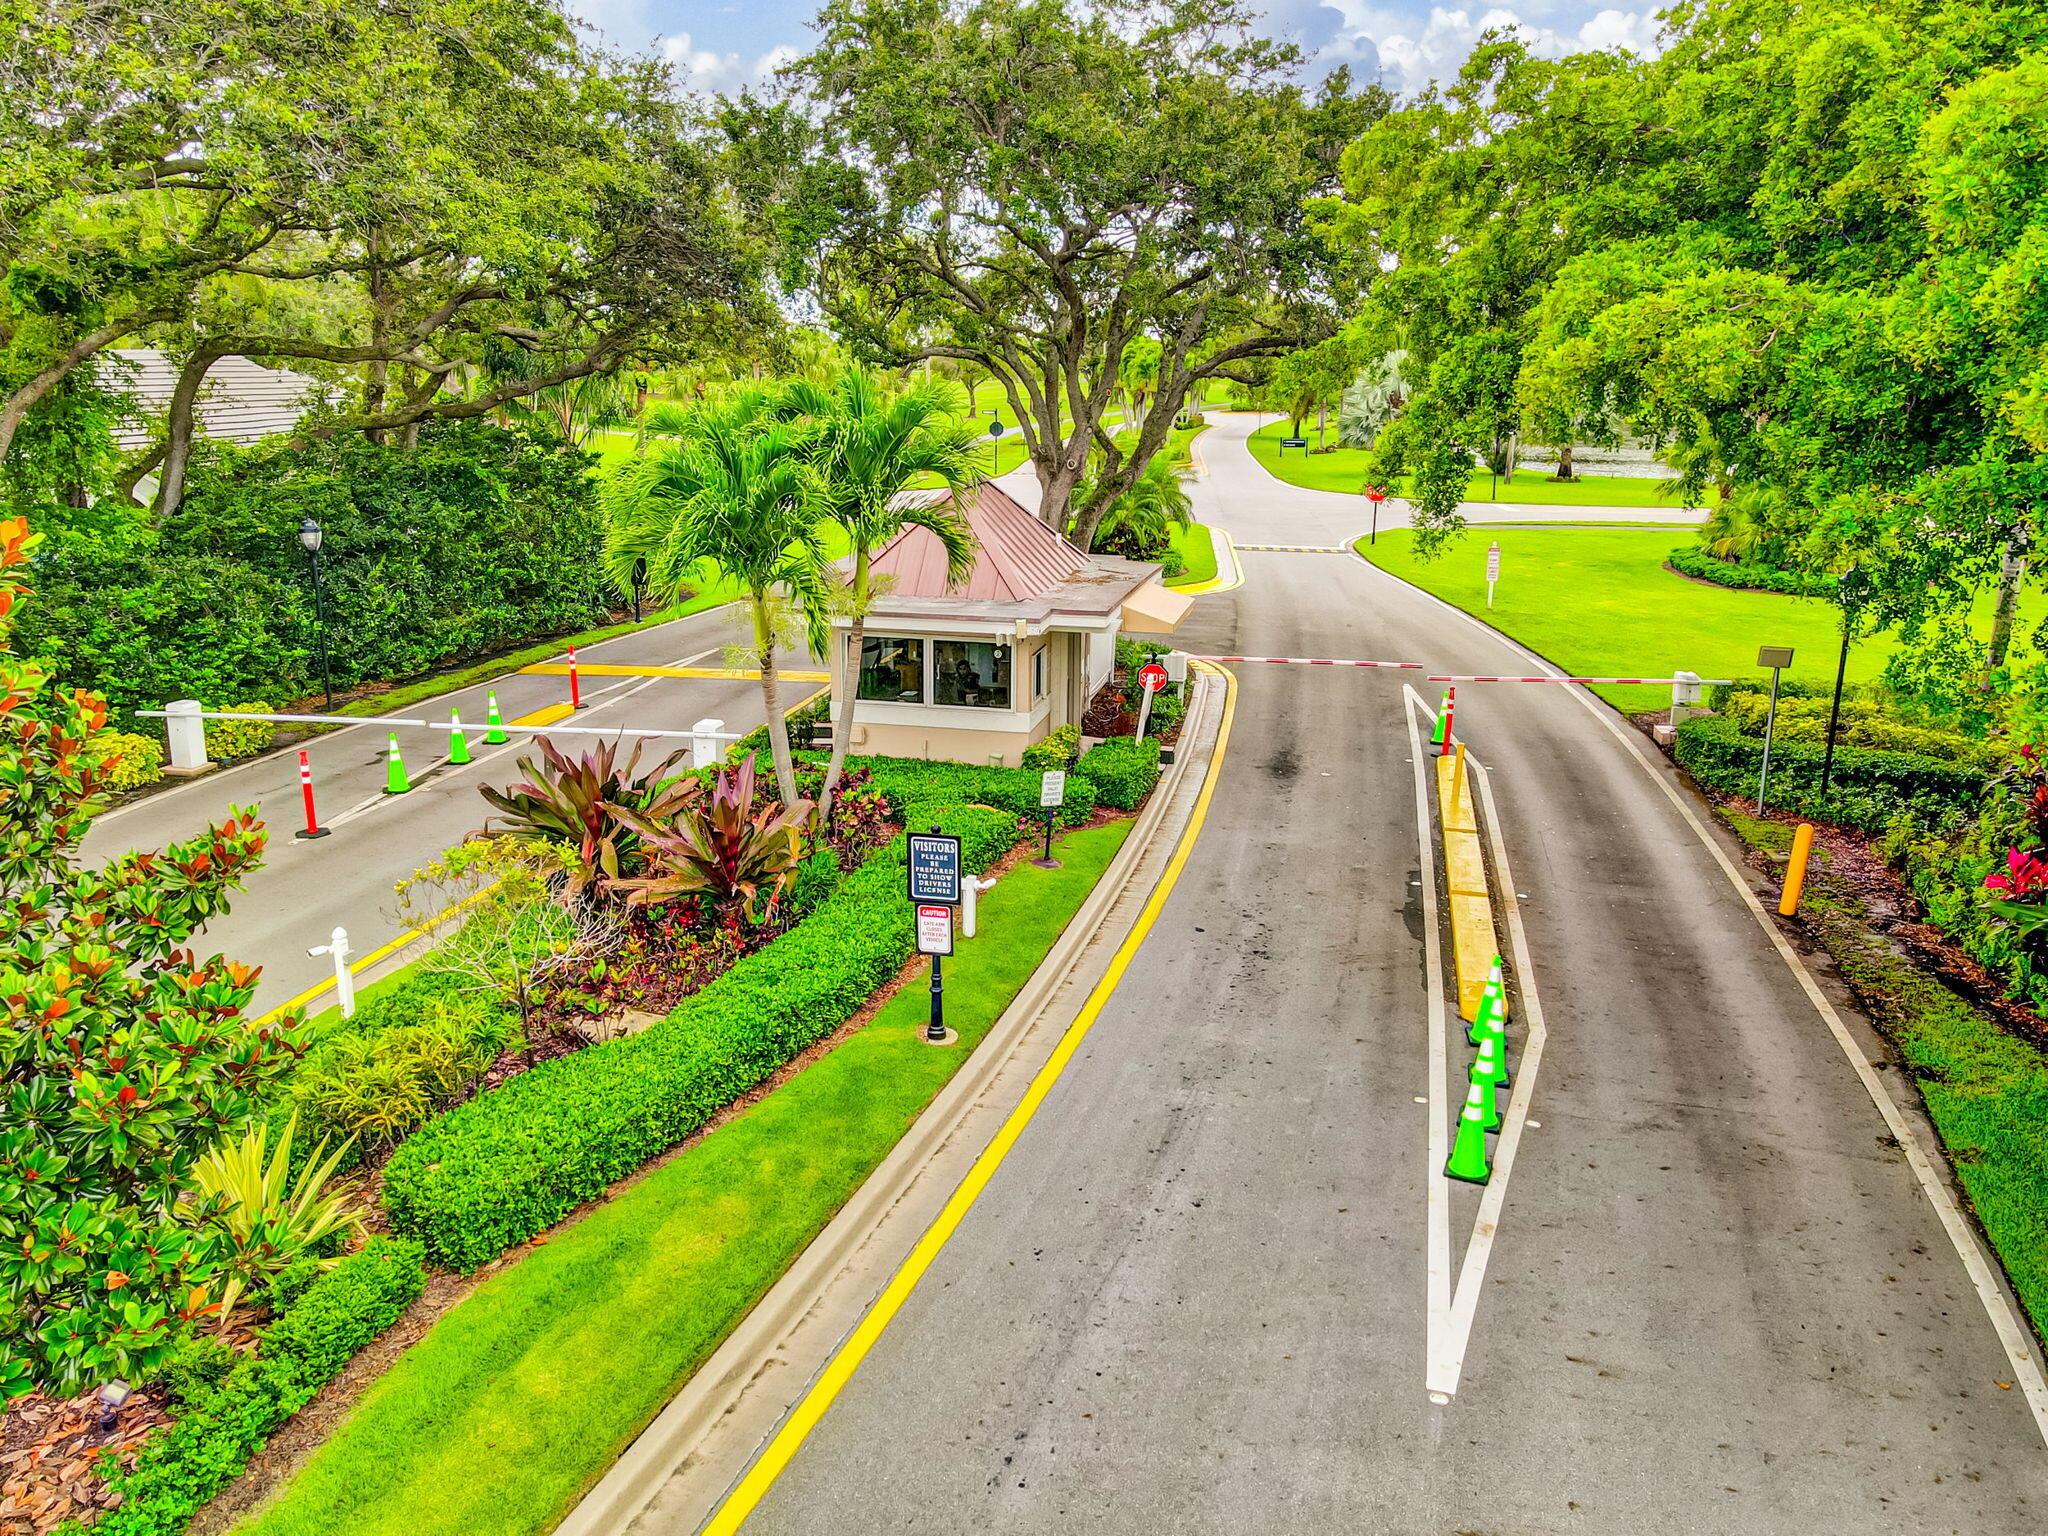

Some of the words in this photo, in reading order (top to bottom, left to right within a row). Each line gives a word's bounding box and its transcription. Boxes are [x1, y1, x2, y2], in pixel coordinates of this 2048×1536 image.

[1141, 672, 1165, 683] SOP
[914, 841, 955, 853] VISITORS
[920, 853, 949, 861] PLEASE
[915, 866, 954, 874] PREPARED
[919, 880, 951, 888] DRIVERS
[921, 909, 947, 917] CAUTION
